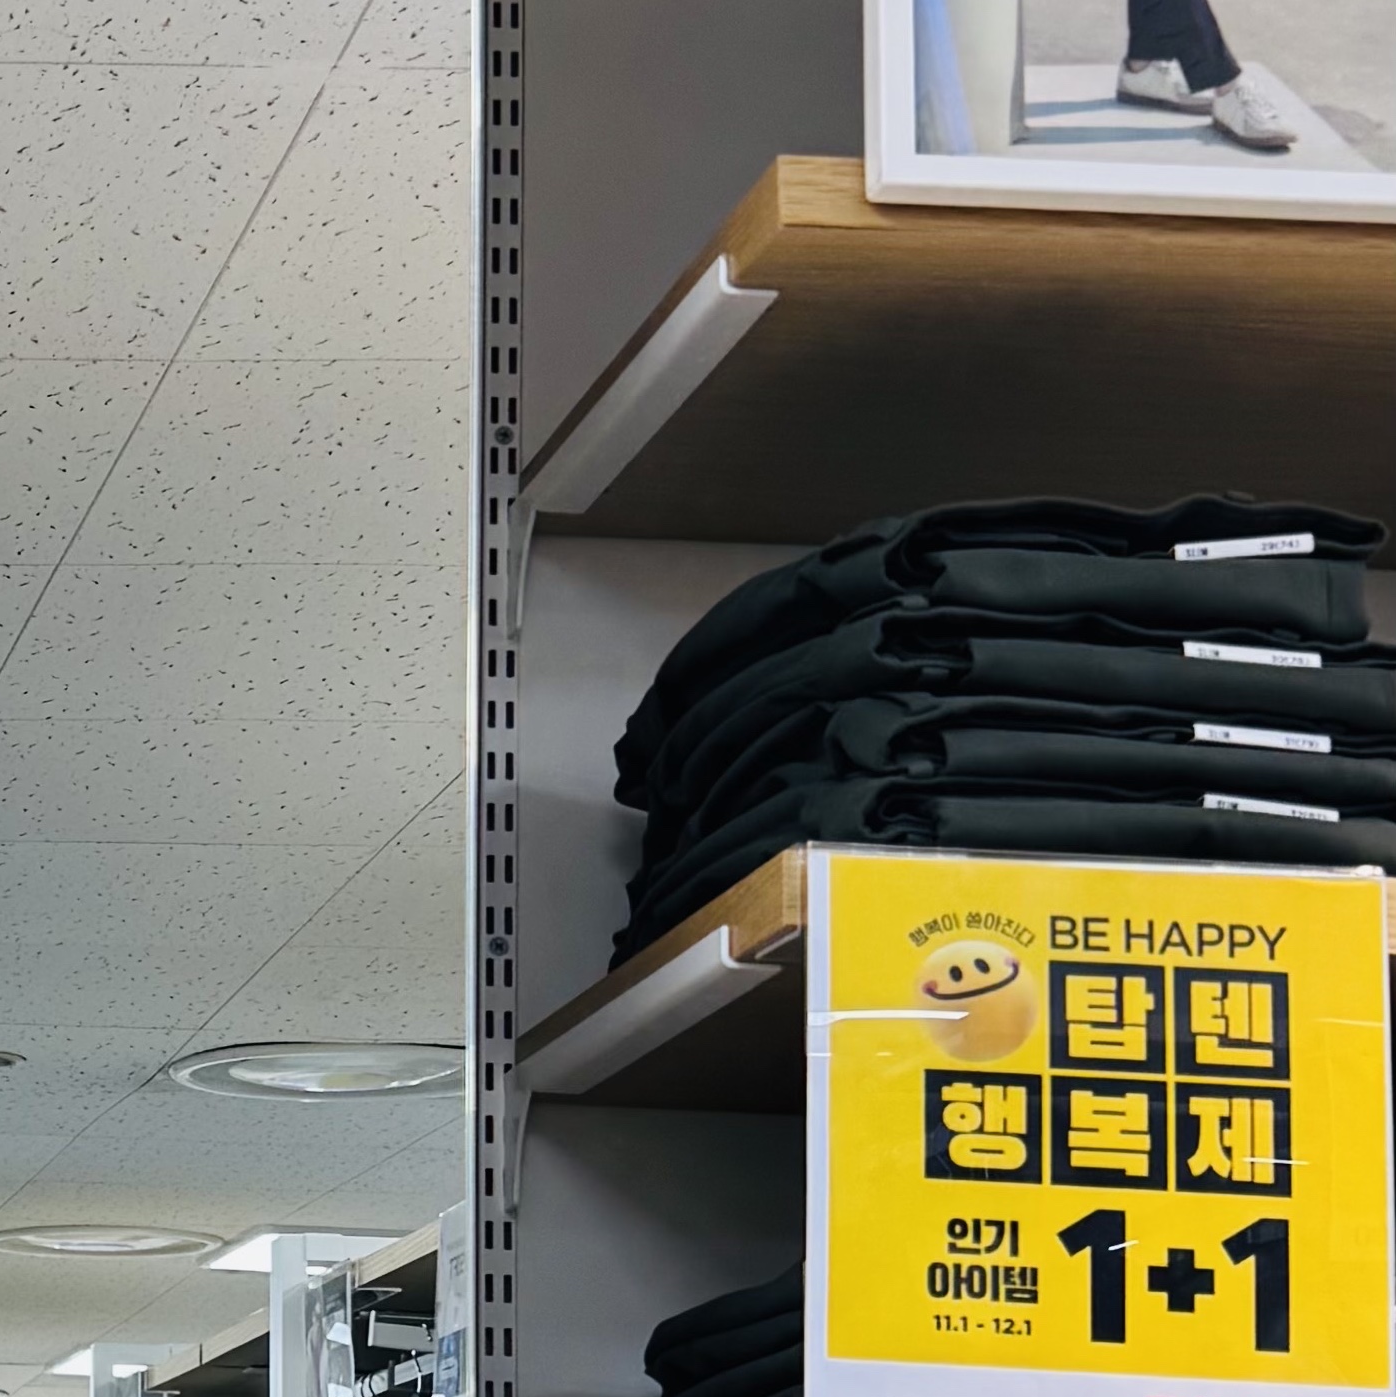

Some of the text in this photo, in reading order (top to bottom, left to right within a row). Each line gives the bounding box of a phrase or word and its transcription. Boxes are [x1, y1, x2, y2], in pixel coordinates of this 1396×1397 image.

[1048, 914, 1287, 961] BE HAPPY
[946, 1217, 1020, 1258] 인기
[926, 1261, 1039, 1305] 아이템
[1056, 1208, 1290, 1353] 1+1
[932, 1313, 969, 1334] 11.1
[992, 1316, 1032, 1337] 12.1
